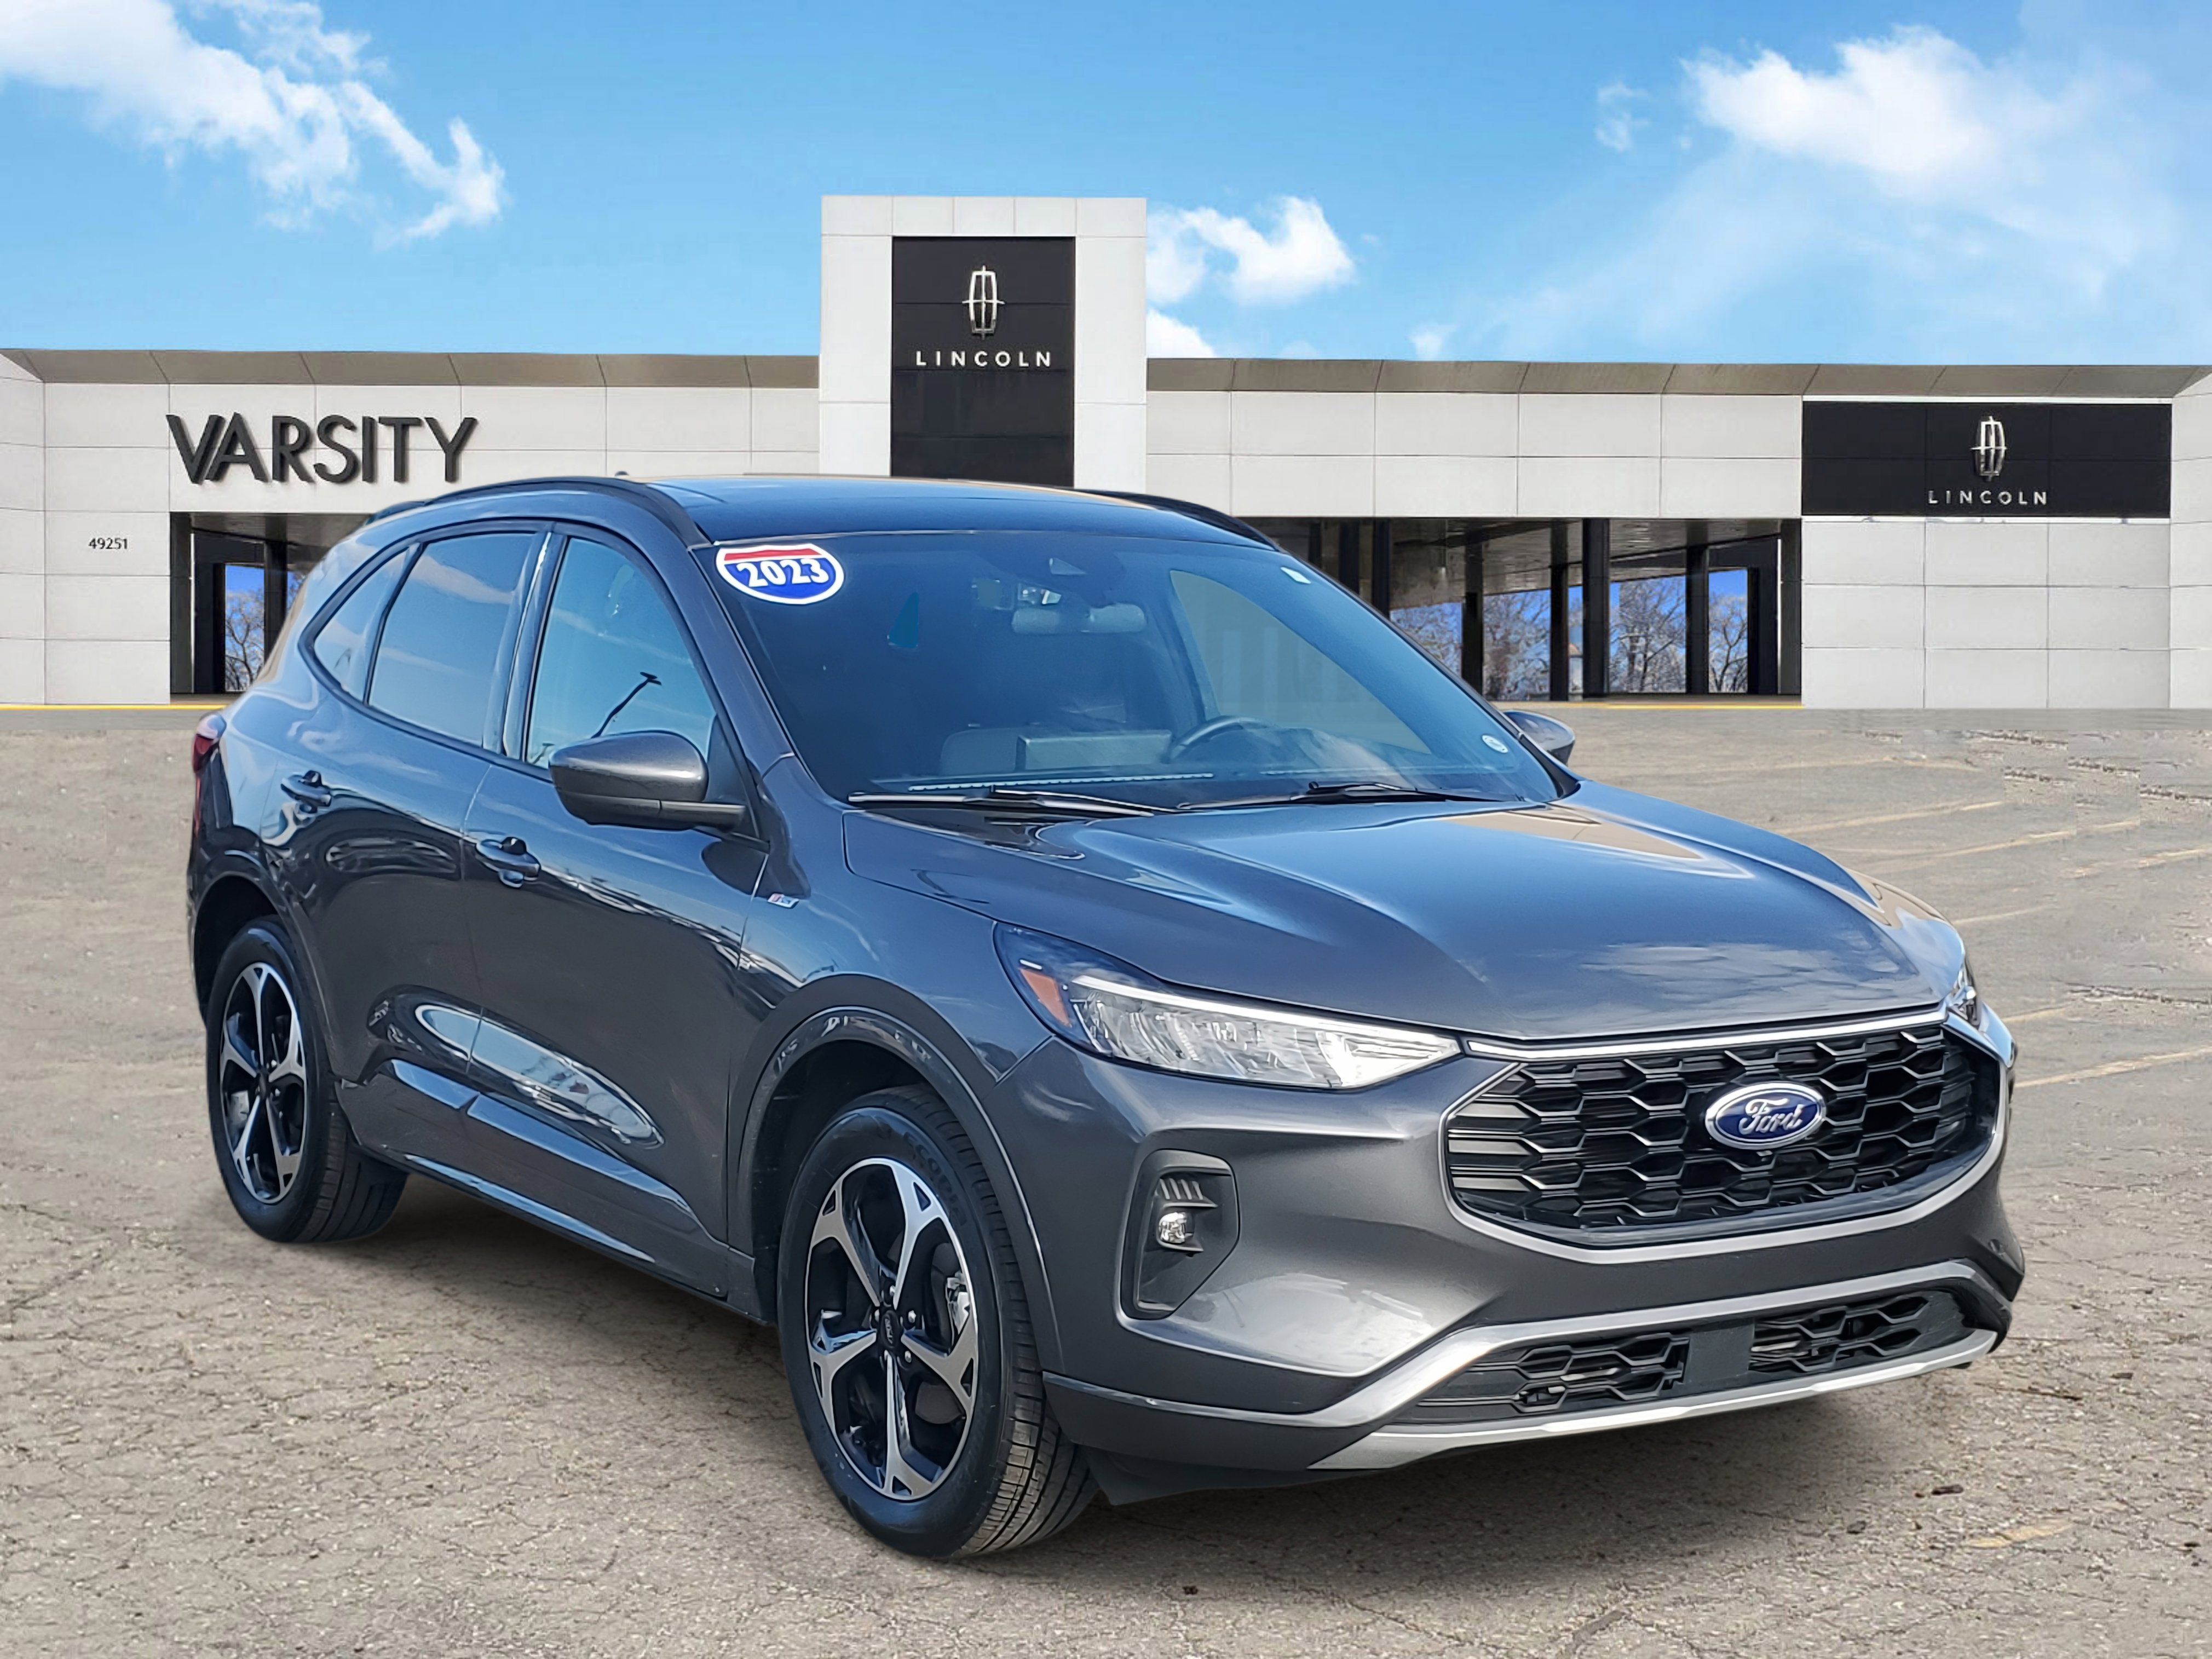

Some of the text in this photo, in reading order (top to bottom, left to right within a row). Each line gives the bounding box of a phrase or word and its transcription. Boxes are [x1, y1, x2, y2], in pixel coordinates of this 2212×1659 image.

[915, 350, 1052, 367] LINCOLN
[165, 412, 478, 484] VARSITY
[1928, 489, 2048, 505] LINCOLN
[88, 537, 128, 550] 49251
[736, 558, 829, 587] 2023
[1738, 1097, 1805, 1135] Ford
